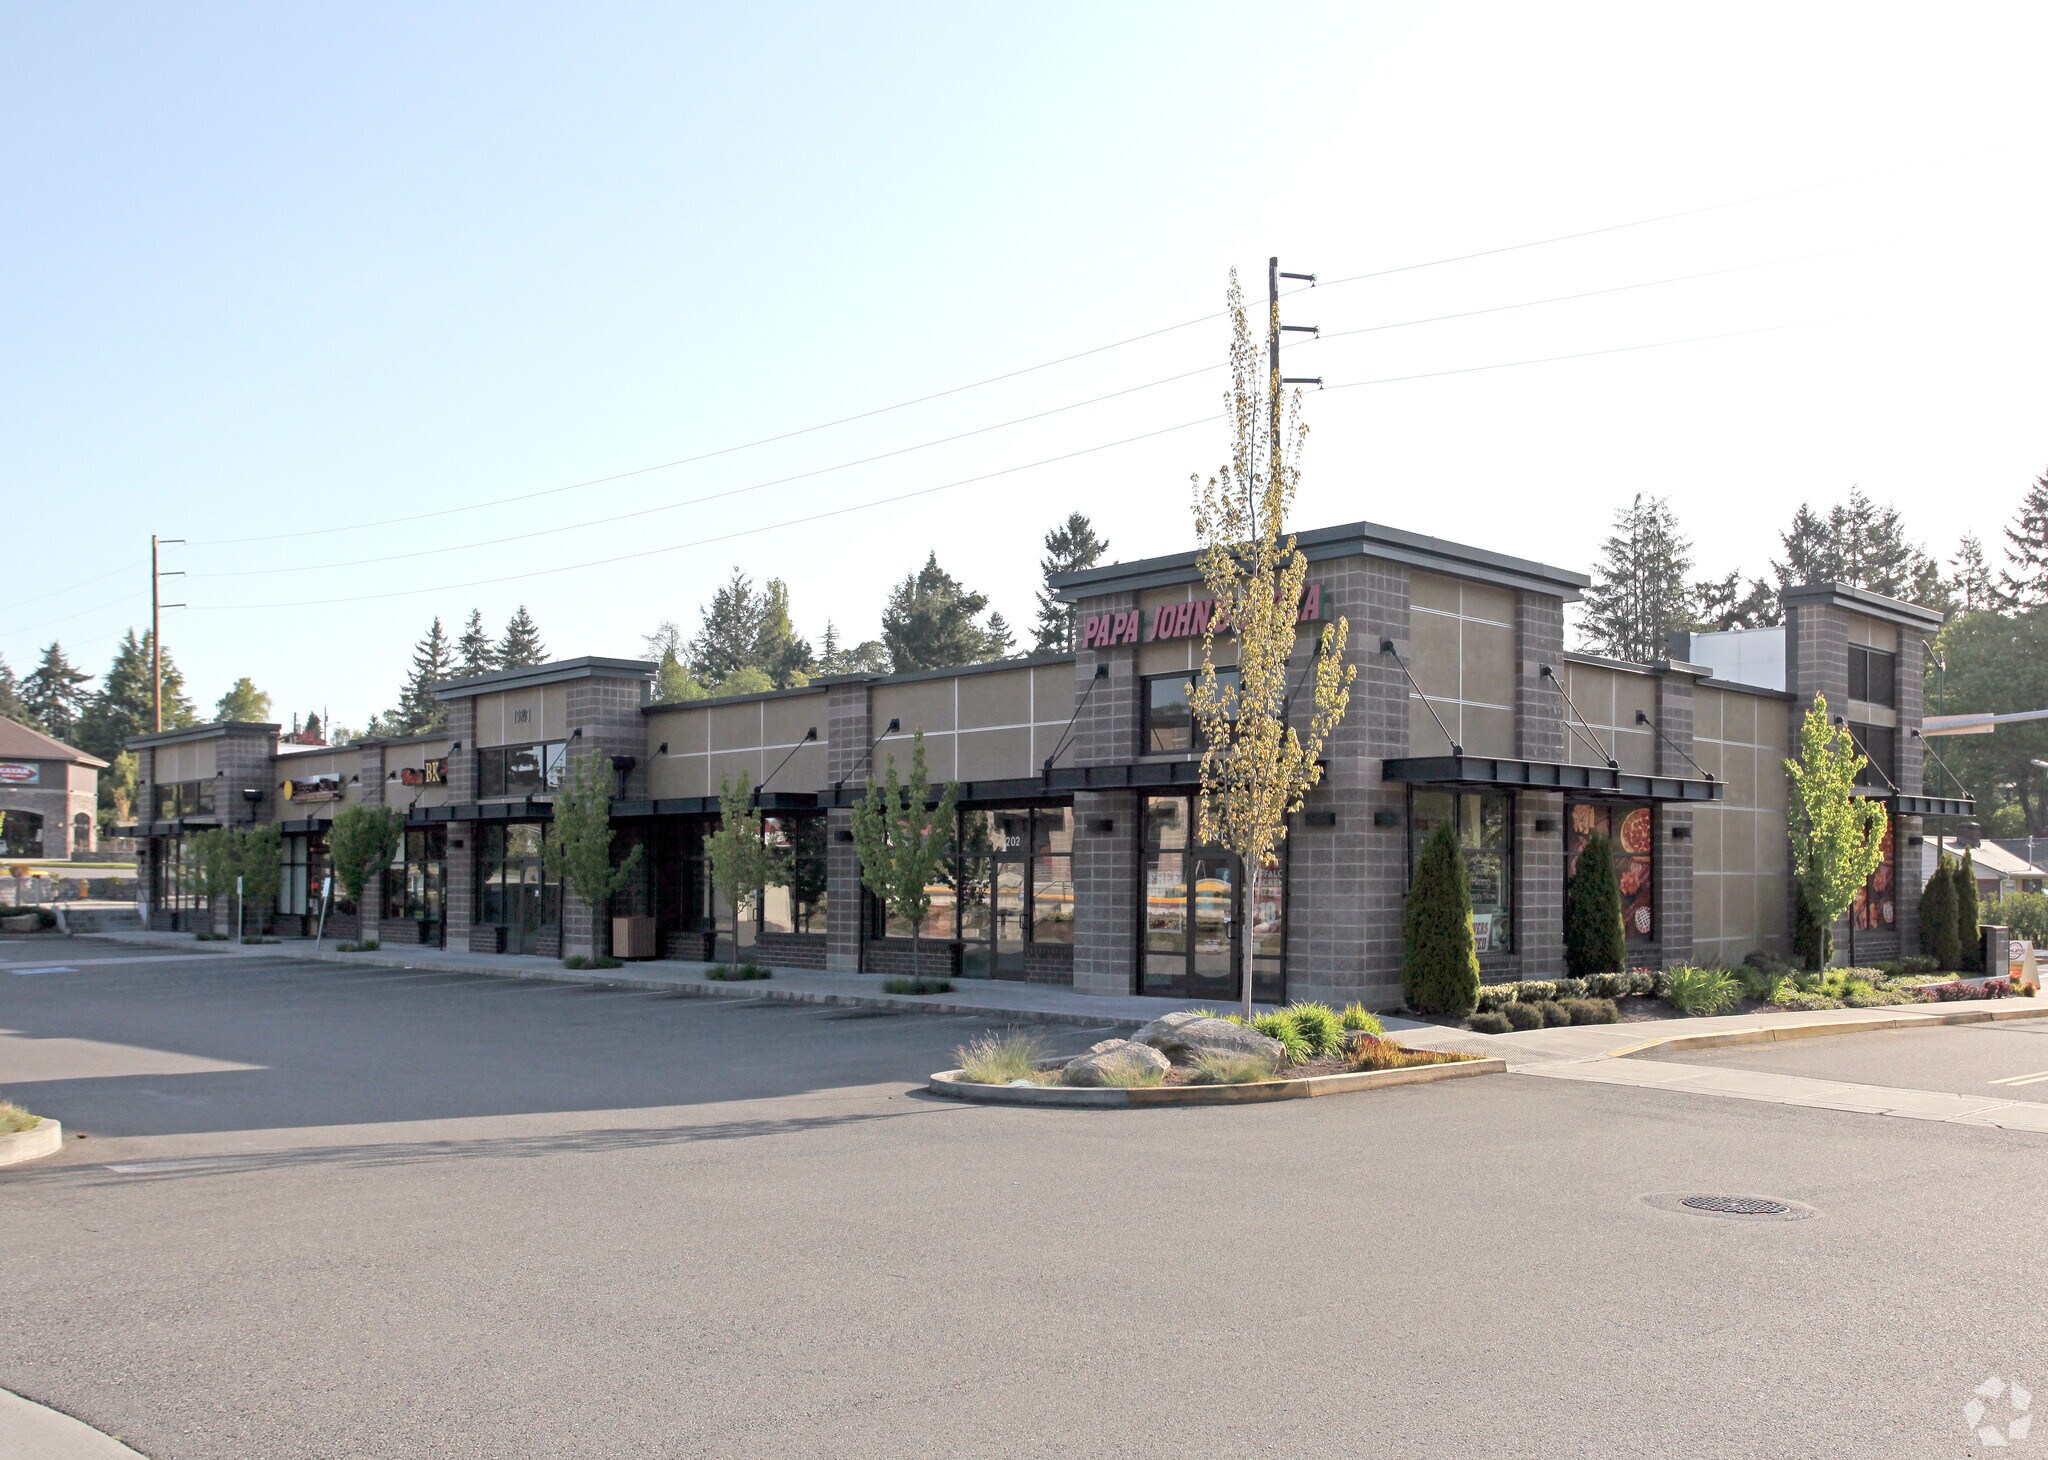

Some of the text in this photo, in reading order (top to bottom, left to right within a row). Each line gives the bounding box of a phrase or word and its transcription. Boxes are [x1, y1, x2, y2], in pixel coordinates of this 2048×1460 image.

[1082, 609, 1140, 649] PAPA
[1150, 598, 1231, 641] JOHNS
[425, 762, 440, 782] BK
[1006, 836, 1020, 847] 202
